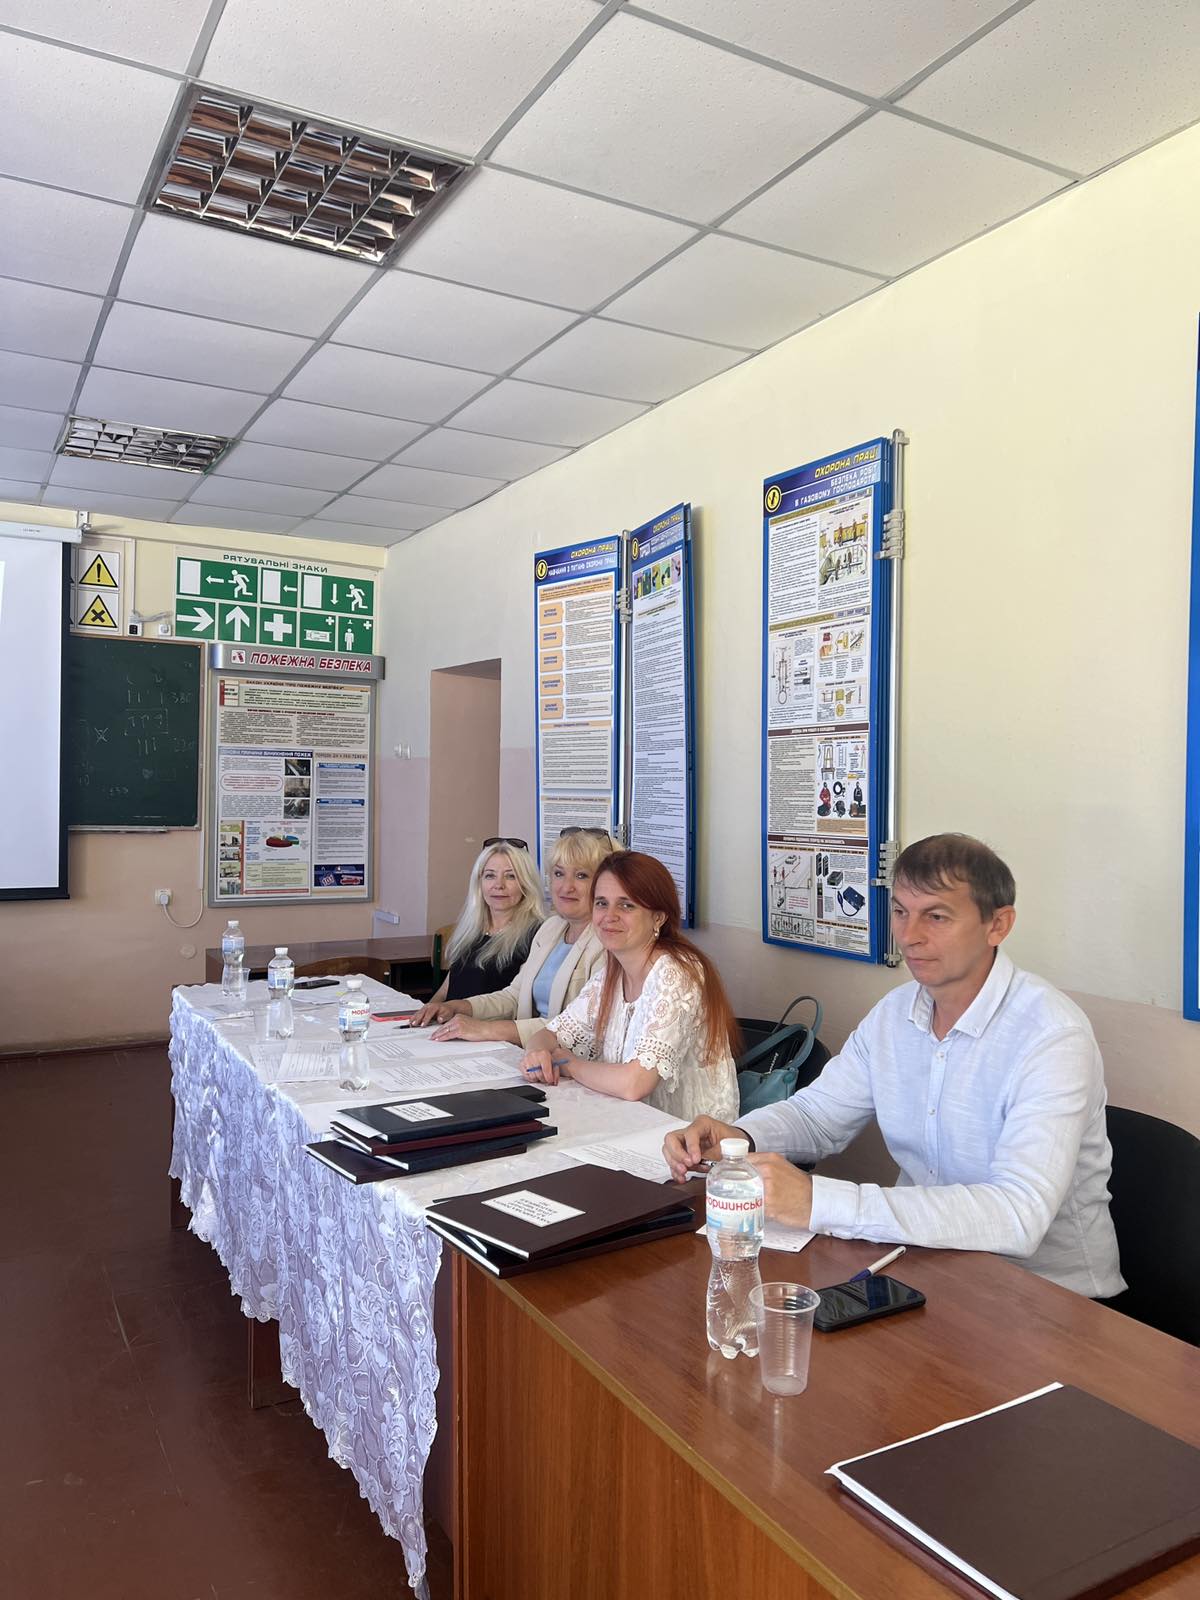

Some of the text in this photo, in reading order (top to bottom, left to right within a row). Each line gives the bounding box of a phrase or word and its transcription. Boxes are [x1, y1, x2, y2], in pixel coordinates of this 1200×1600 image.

[814, 457, 851, 479] ОХОРОНА
[831, 470, 857, 487] БЕЗПЕКА
[223, 554, 328, 573] РЯТУВАЛЬНІ ЗНАКИ
[250, 653, 372, 672] ПОЖЕЖНА БЕЗПЕКА
